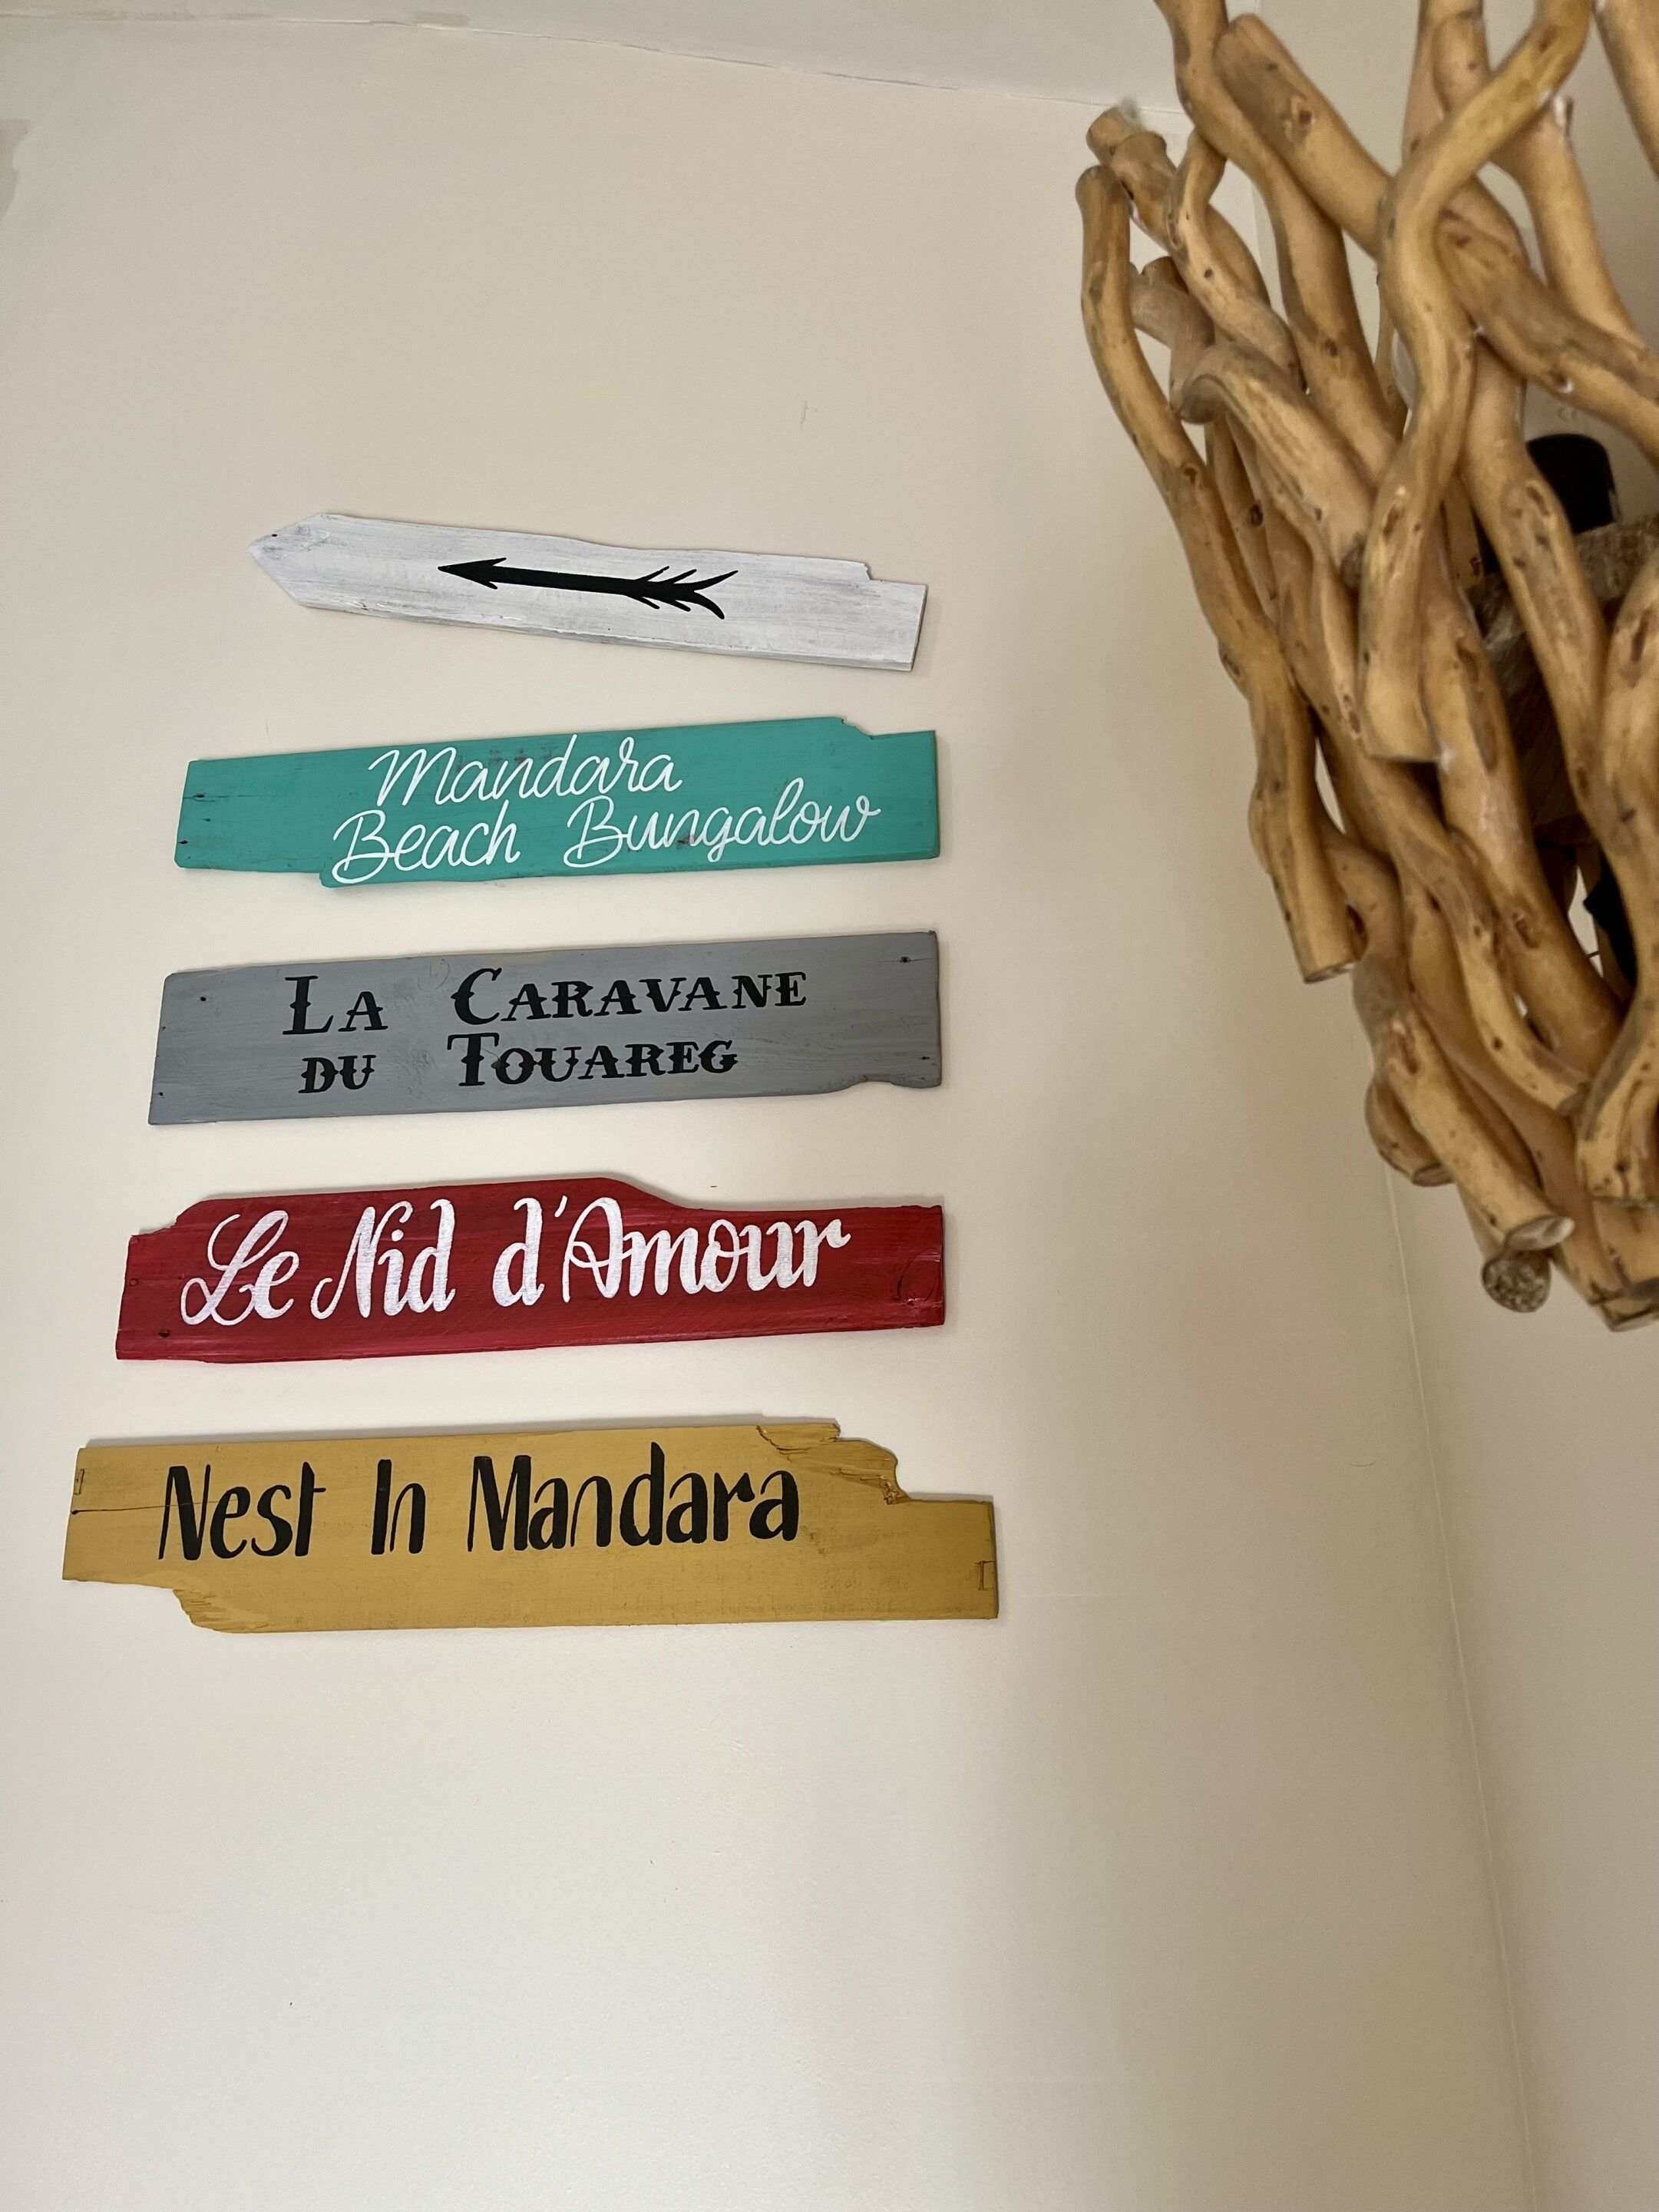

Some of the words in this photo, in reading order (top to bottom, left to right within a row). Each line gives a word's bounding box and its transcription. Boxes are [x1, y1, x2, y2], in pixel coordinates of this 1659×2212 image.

[368, 734, 682, 807] Mandara
[332, 799, 521, 884] Beach
[563, 778, 881, 868] Bungalow
[282, 976, 388, 1036] LA
[450, 967, 807, 1026] CARAVANE
[298, 1054, 377, 1094] DU
[447, 1032, 739, 1087] TOUAREG
[181, 1210, 299, 1326] Le
[310, 1199, 456, 1320] Nid
[492, 1195, 851, 1308] d'Amour
[158, 1461, 326, 1561] Nest
[371, 1459, 426, 1556] In
[467, 1441, 800, 1552] Mandara
